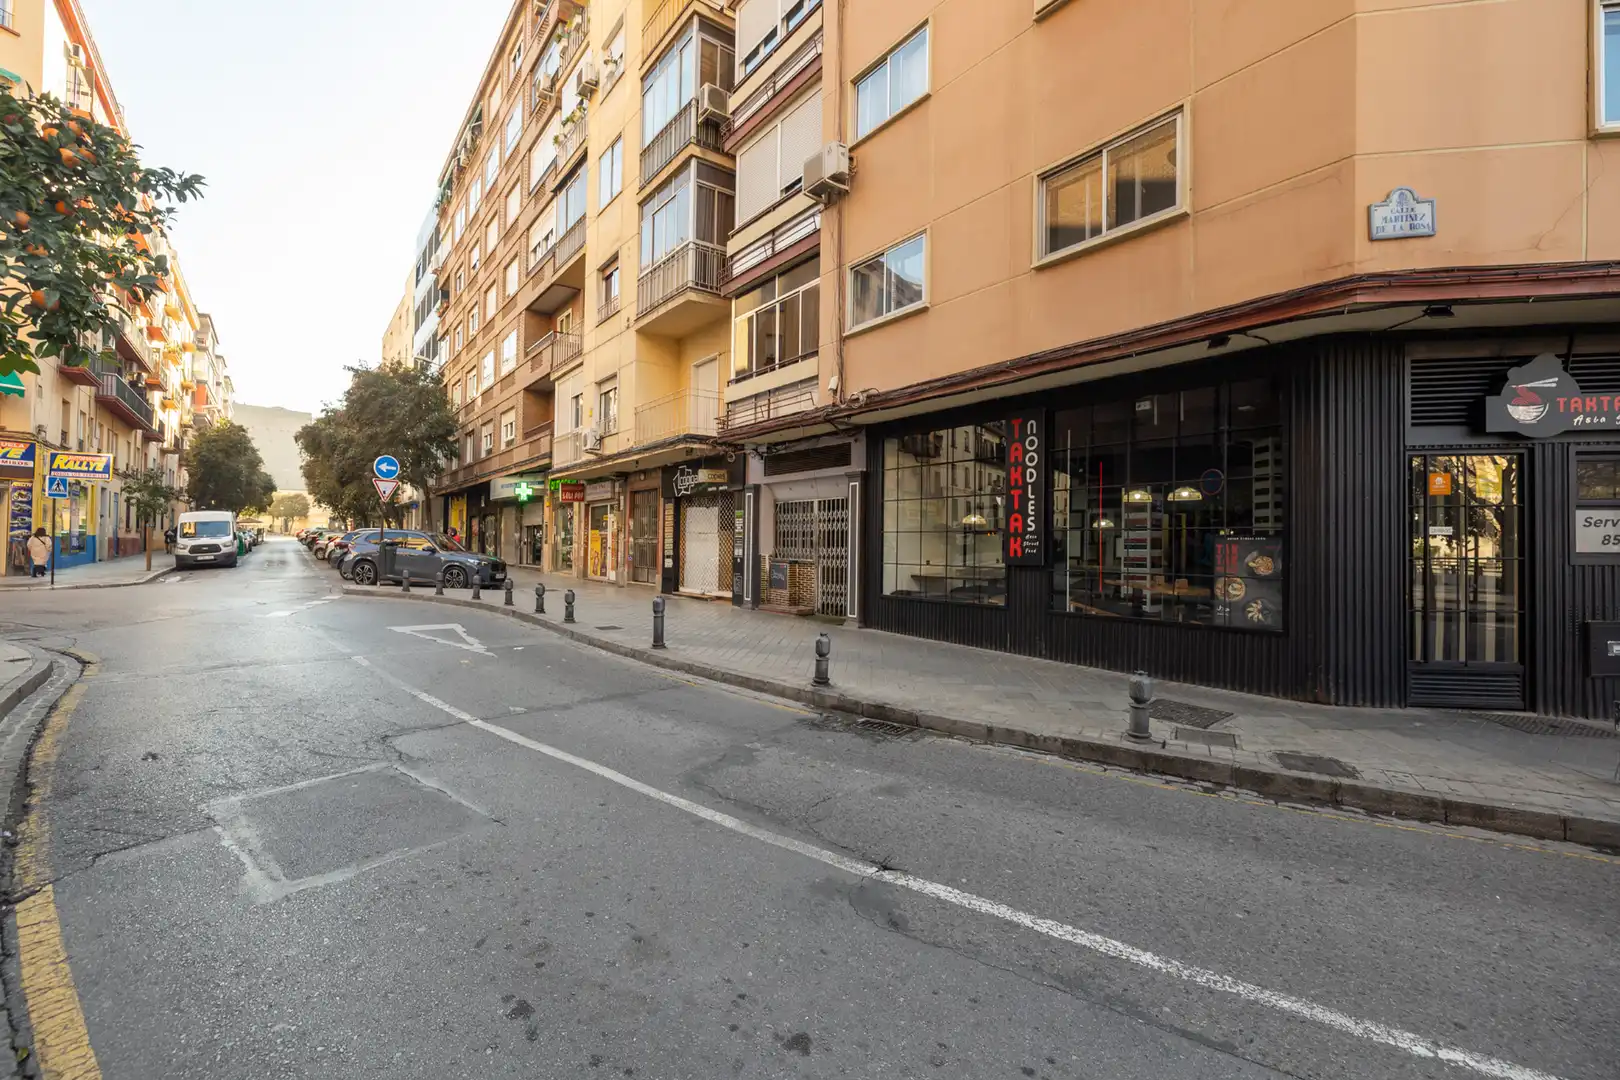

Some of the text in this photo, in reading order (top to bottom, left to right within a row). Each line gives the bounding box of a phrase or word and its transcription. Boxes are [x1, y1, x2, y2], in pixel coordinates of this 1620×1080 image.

[1375, 225, 1386, 235] DE
[1409, 220, 1432, 231] ROSA
[1573, 414, 1607, 426] Asia
[52, 454, 107, 472] RALLYE
[1009, 418, 1023, 558] TAKTAK
[1582, 516, 1620, 528] Serv
[1601, 534, 1620, 546] 85
